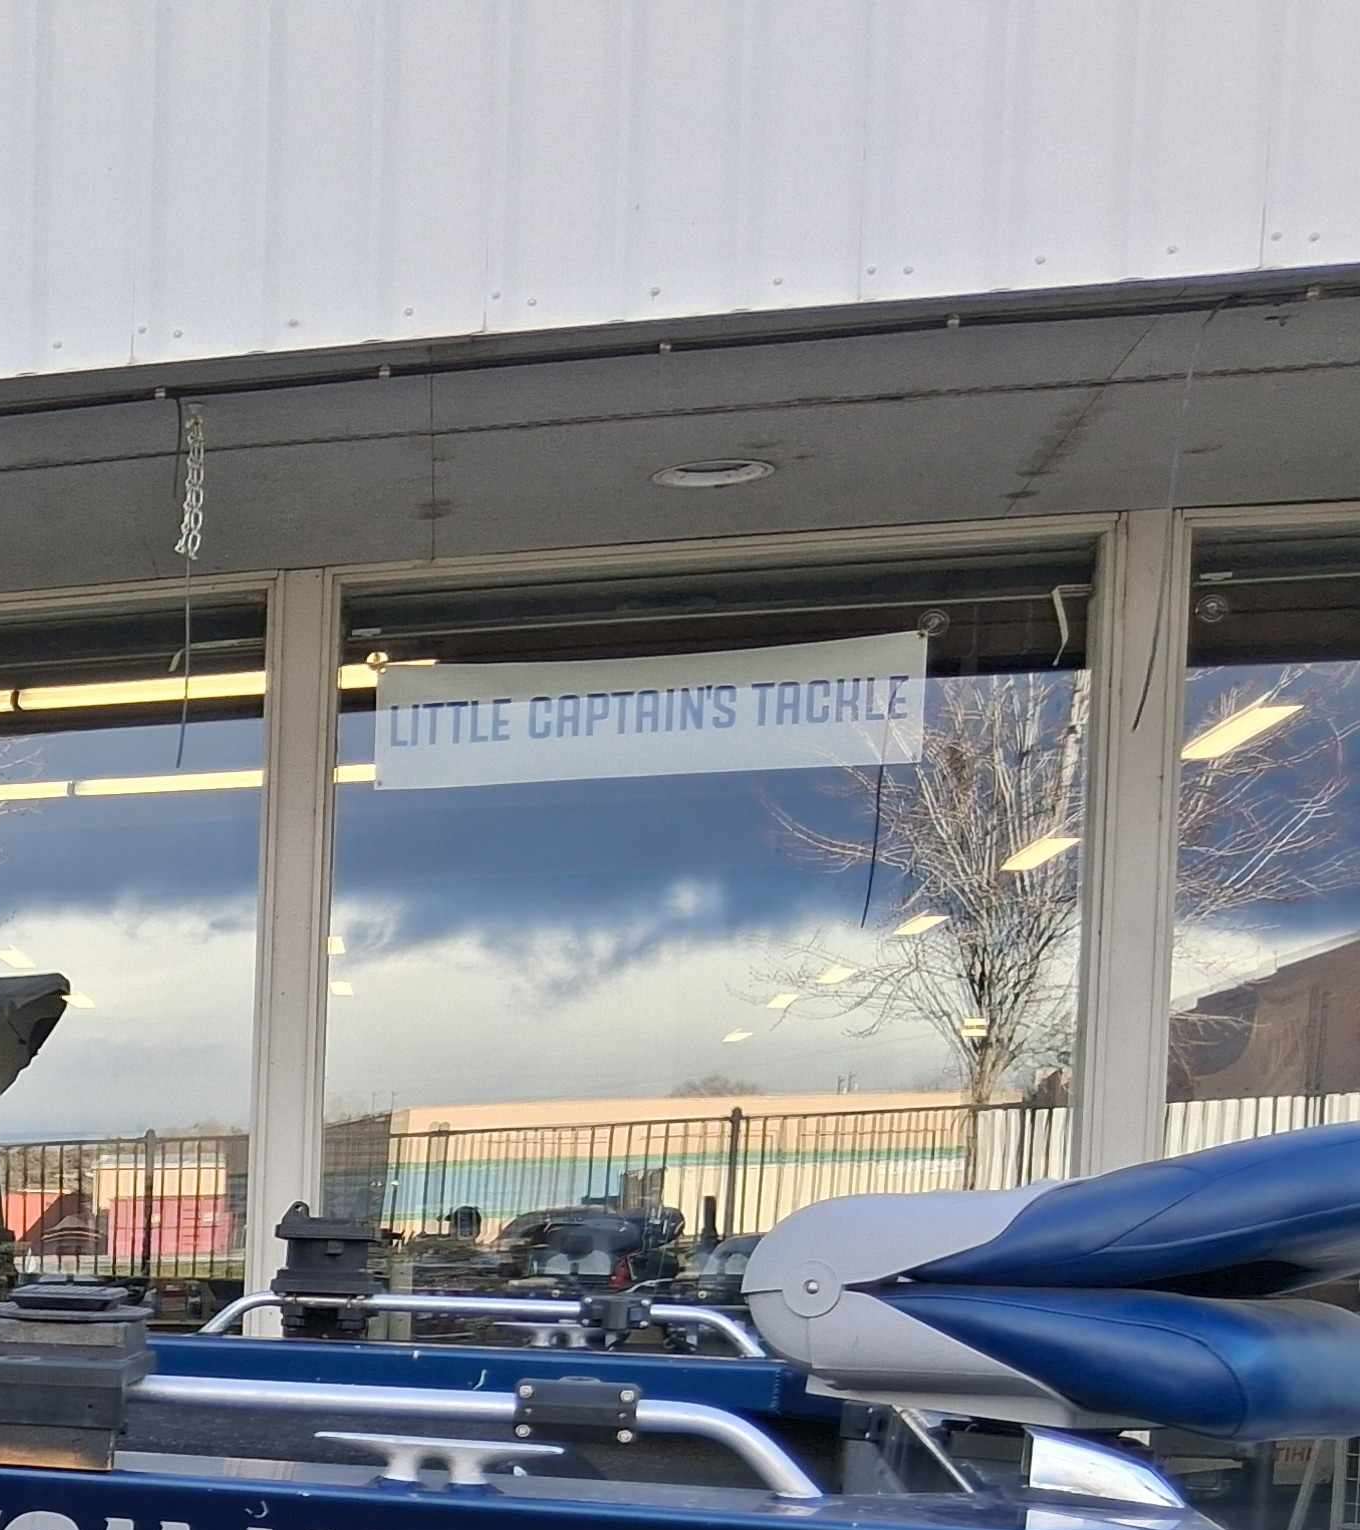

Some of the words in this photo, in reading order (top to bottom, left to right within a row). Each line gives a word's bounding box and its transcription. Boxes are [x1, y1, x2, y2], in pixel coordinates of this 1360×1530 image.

[389, 697, 512, 748] LITTLE
[528, 683, 738, 740] CAPTAIN'S
[751, 675, 910, 727] TACKLE
